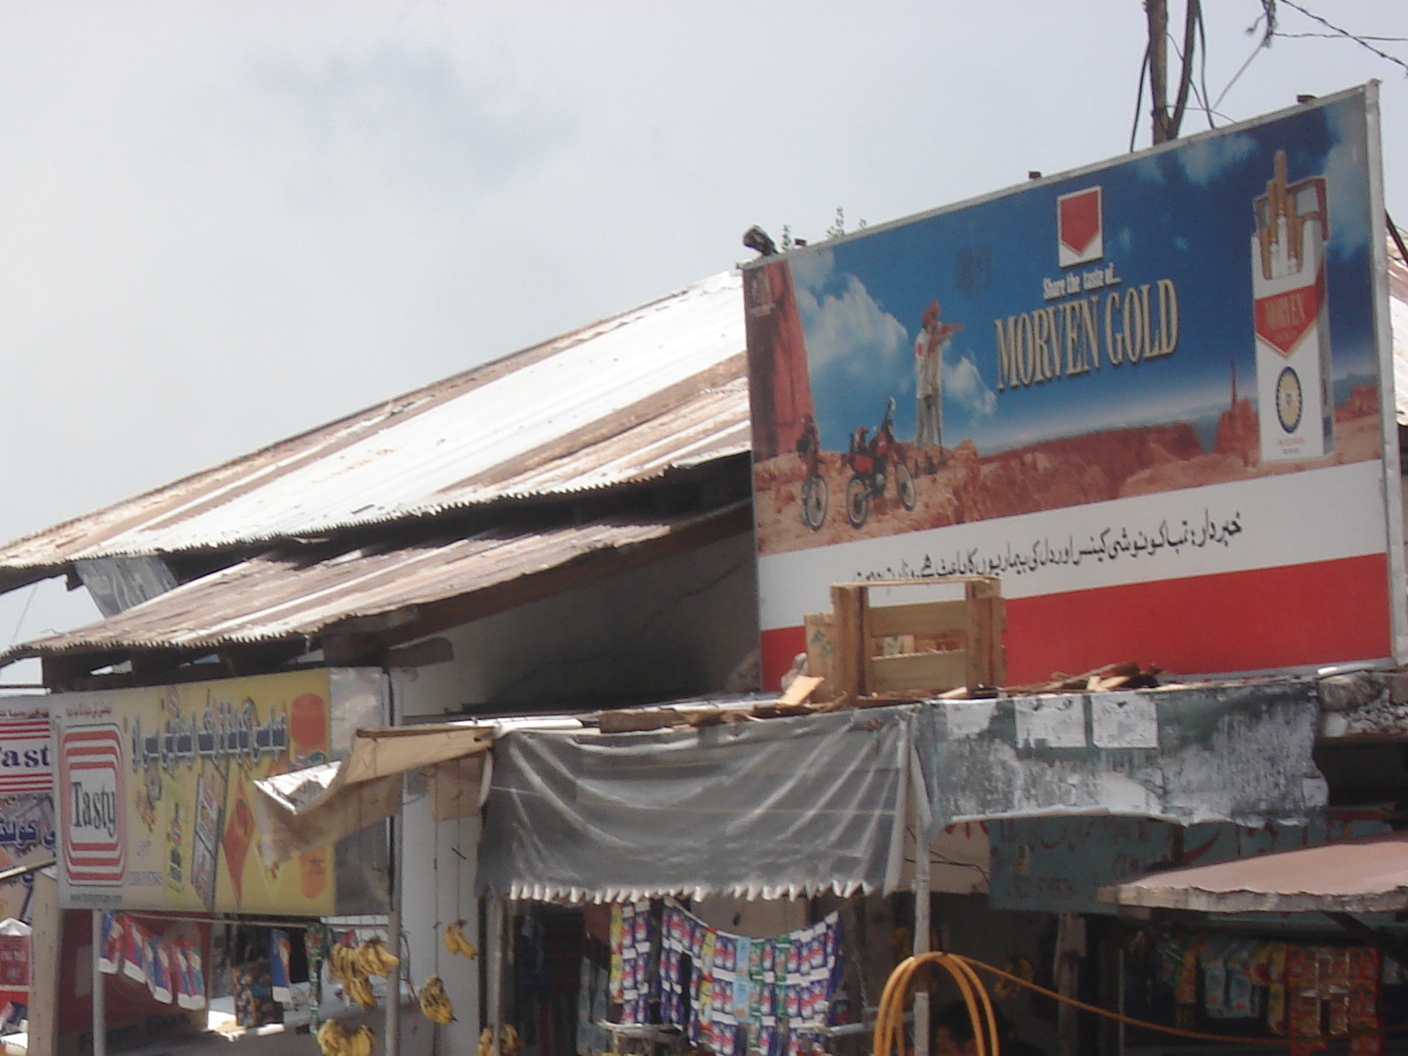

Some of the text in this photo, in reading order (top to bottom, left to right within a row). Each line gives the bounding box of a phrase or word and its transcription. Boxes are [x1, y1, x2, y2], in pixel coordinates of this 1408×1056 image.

[994, 278, 1179, 392] MORVEN GOLD
[71, 781, 117, 839] Tasty
